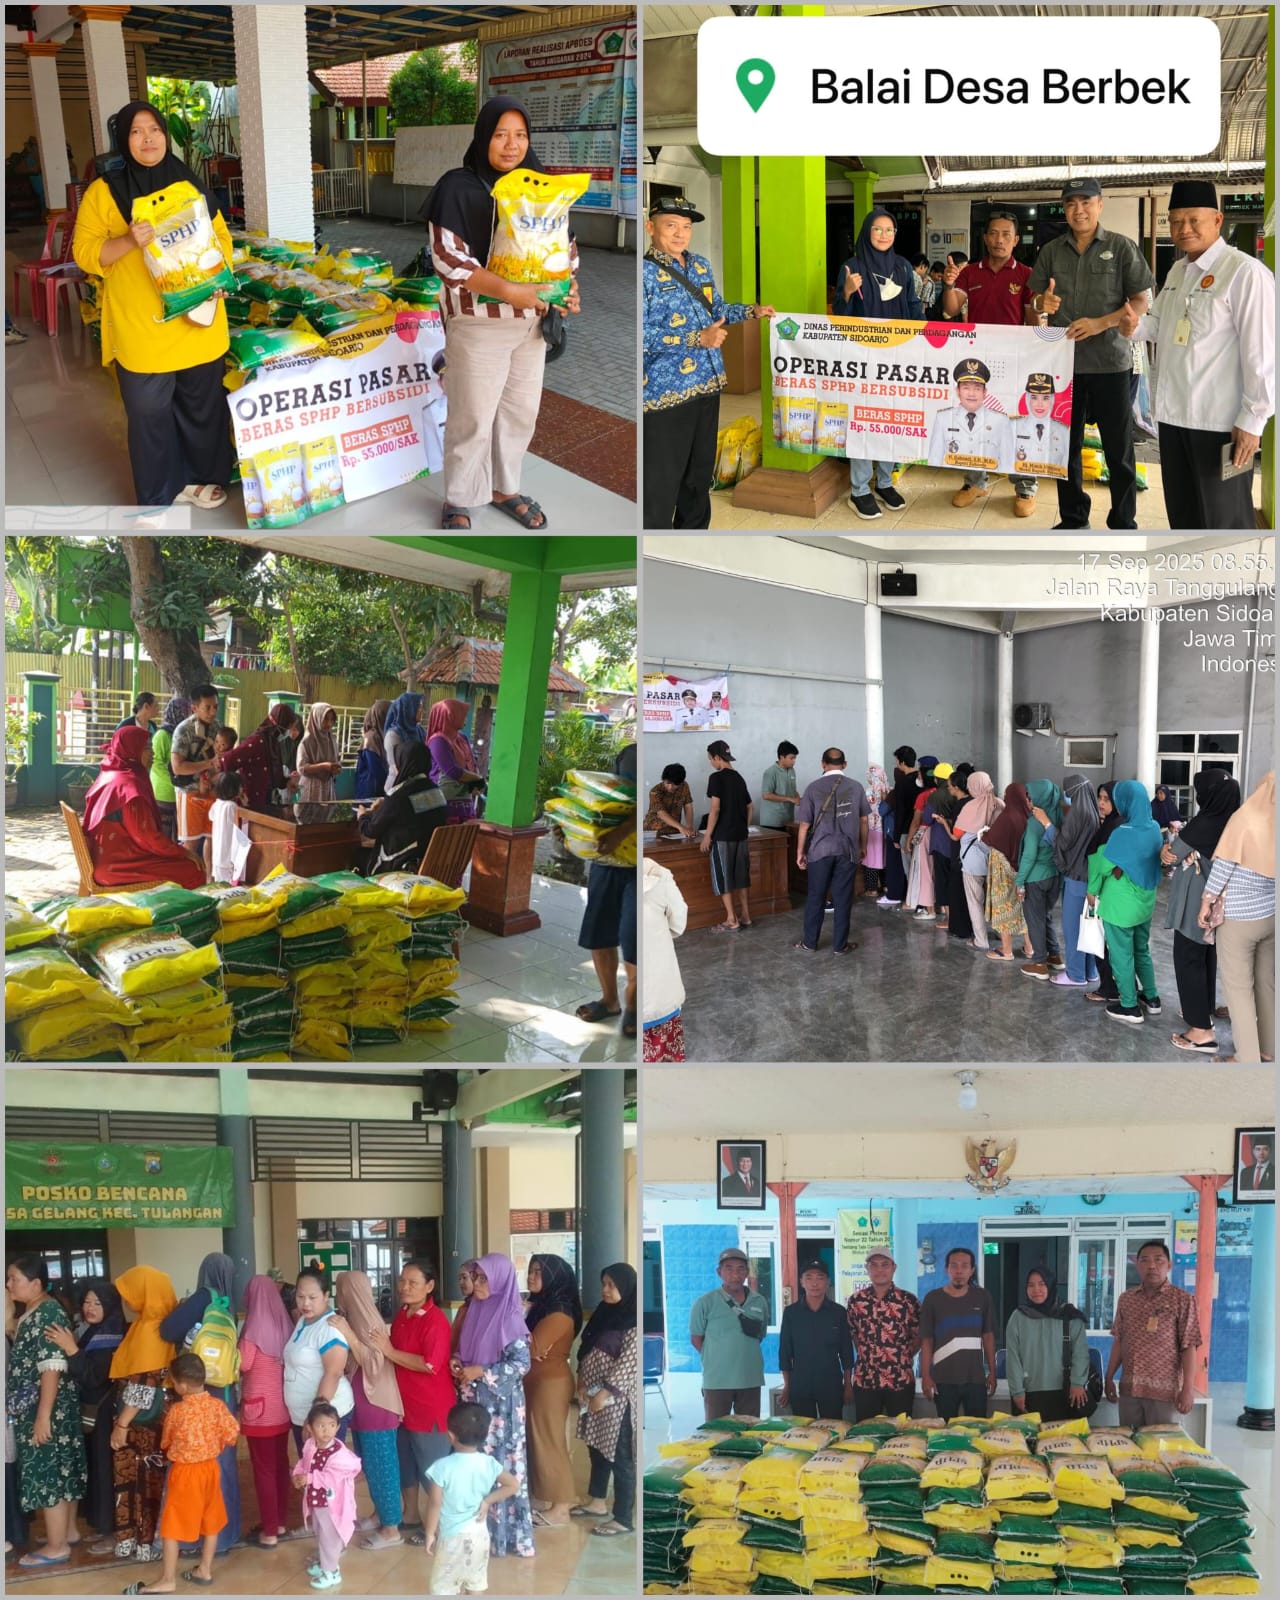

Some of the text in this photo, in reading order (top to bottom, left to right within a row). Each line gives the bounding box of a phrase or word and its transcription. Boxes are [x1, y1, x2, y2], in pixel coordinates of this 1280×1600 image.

[503, 37, 593, 58] LAPORAN REALISASI APBDES
[576, 53, 592, 62] 2024
[520, 214, 567, 231] SPHP
[160, 219, 201, 248] SPHP
[366, 327, 385, 338] DAN
[803, 323, 977, 339] DINAS PERINDUSTRIAN DAN PERDAGANGAN
[803, 332, 889, 344] KABUPATEN SIDOARJO
[774, 356, 950, 385] OPERASI PASAR
[236, 363, 431, 421] OPERASI PASAR
[775, 376, 949, 400] BERAS SPHP BERSUBSIDI
[241, 384, 430, 444] BERAS SPHP BERSUBSIDI
[789, 412, 811, 420] SPHP
[856, 409, 922, 424] BERAS SPHP
[824, 419, 845, 427] SPHP
[850, 421, 928, 438] Rp. 55.000/SAK
[343, 418, 410, 448] BERAS SPHP
[341, 433, 420, 468] Rp. 55.000/SAK
[271, 464, 297, 480] SPHP
[313, 459, 336, 473] SPHP
[647, 691, 680, 700] PASAR
[123, 946, 177, 965] SPHP
[22, 1186, 188, 1201] POSKO BENCANA
[32, 1207, 98, 1219] GELANG
[102, 1207, 138, 1219] KEC.
[141, 1207, 223, 1219] TULANGAN
